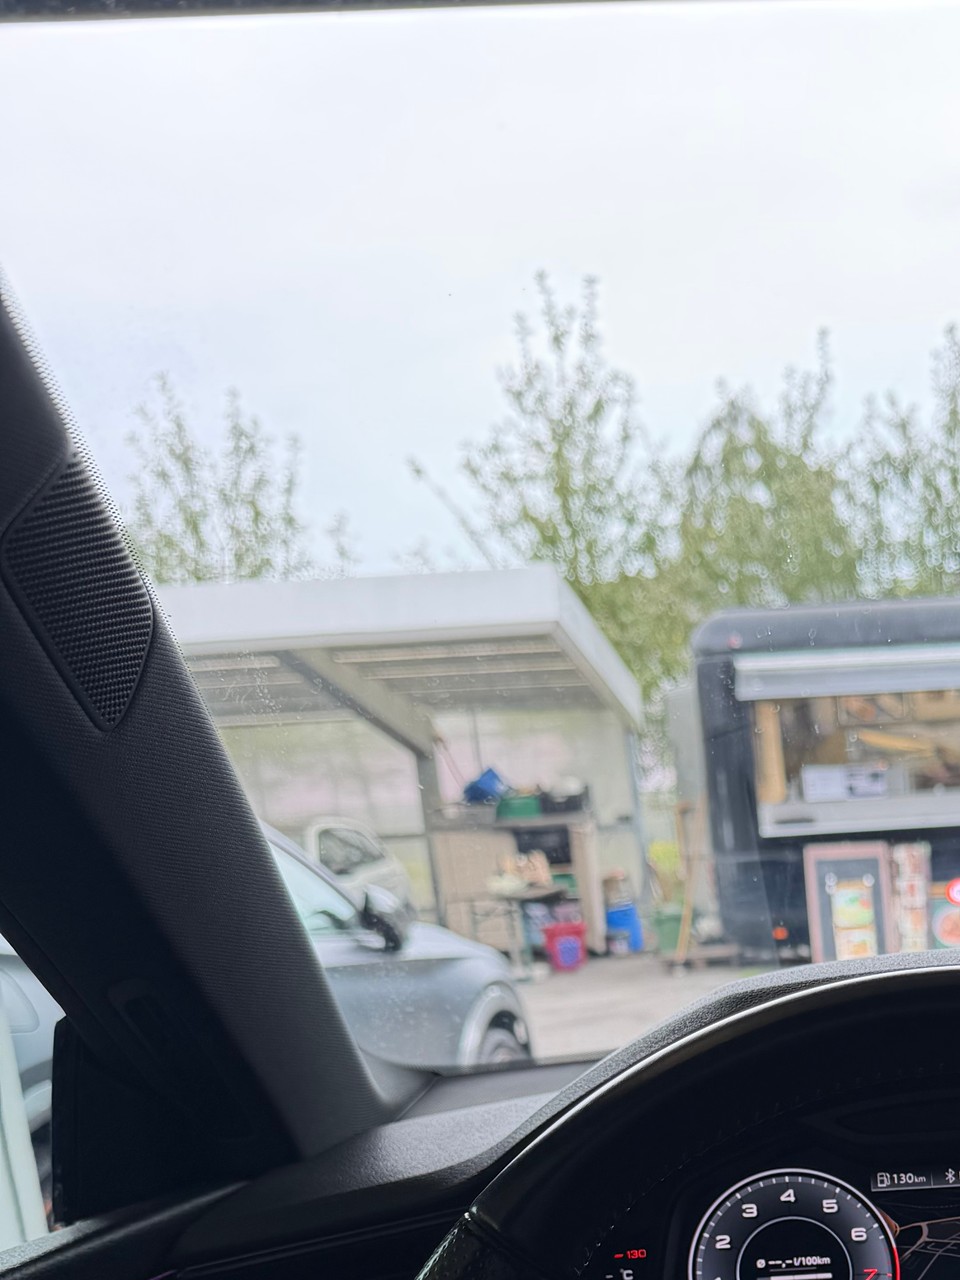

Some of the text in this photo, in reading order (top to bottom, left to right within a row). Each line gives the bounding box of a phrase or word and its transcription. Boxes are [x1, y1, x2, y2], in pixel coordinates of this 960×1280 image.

[779, 1189, 796, 1203] 4
[742, 1204, 758, 1218] 3
[822, 1199, 839, 1213] 5
[851, 1227, 867, 1241] 6
[716, 1235, 731, 1249] 2
[626, 1249, 647, 1259] 130
